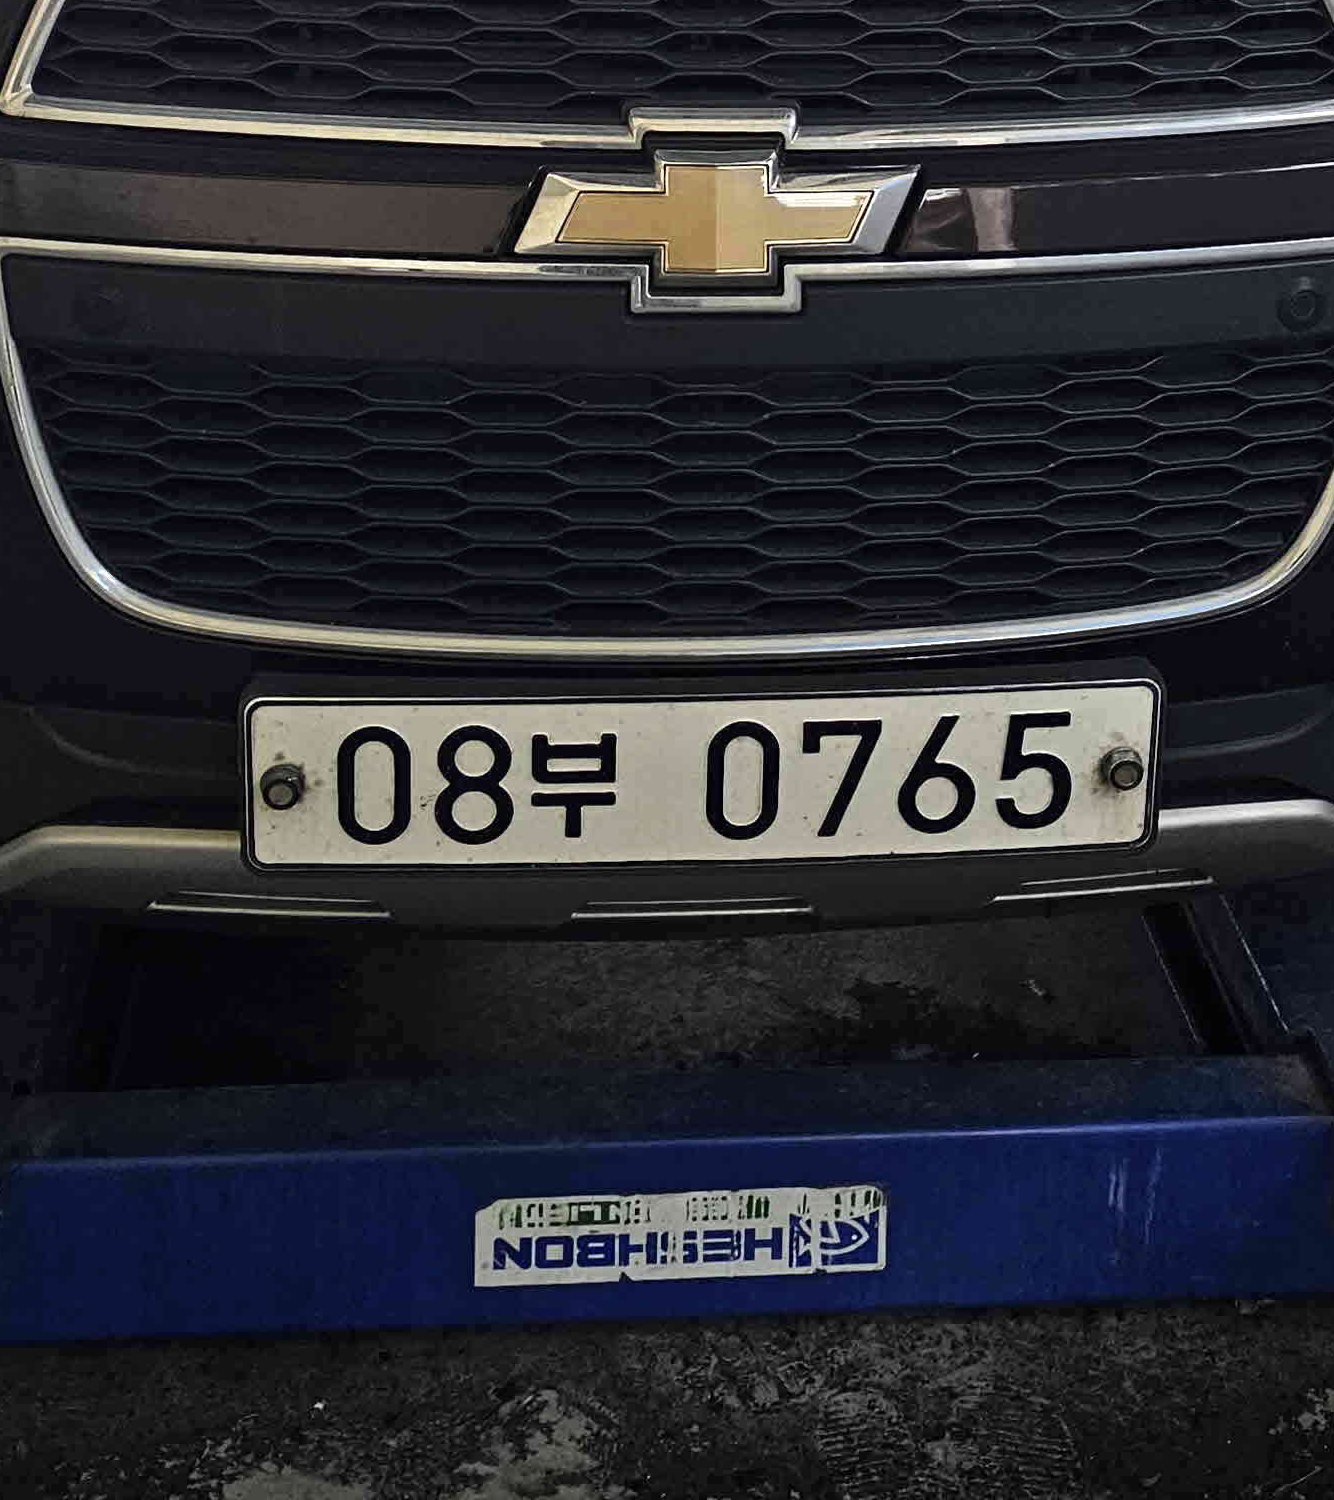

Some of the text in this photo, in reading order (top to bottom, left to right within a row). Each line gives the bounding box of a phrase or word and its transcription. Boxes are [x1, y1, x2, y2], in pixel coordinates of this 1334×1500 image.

[336, 711, 1072, 846] 08부 0765
[492, 1227, 784, 1270] HESHBON
